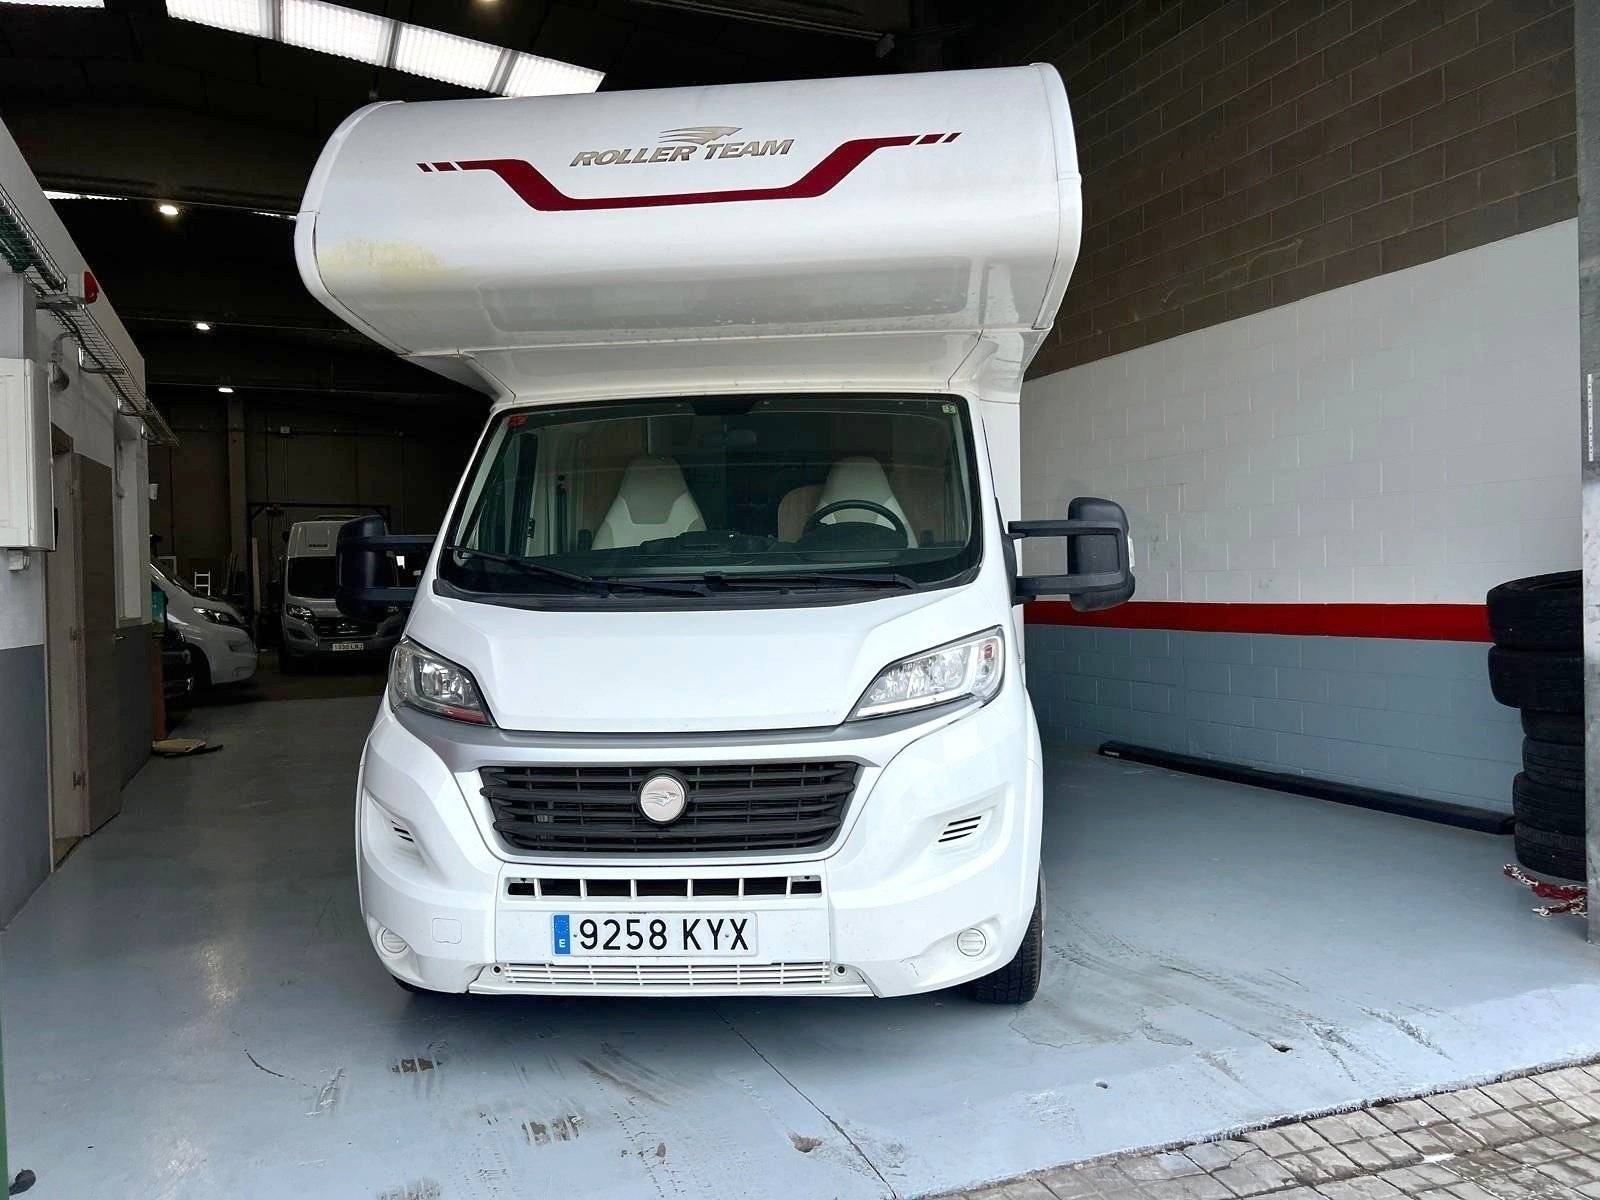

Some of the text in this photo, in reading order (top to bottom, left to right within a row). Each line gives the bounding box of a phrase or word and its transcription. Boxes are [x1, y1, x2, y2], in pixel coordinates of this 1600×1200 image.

[569, 138, 795, 167] ROLLER TEAM
[579, 918, 749, 951] 9258 KYX
